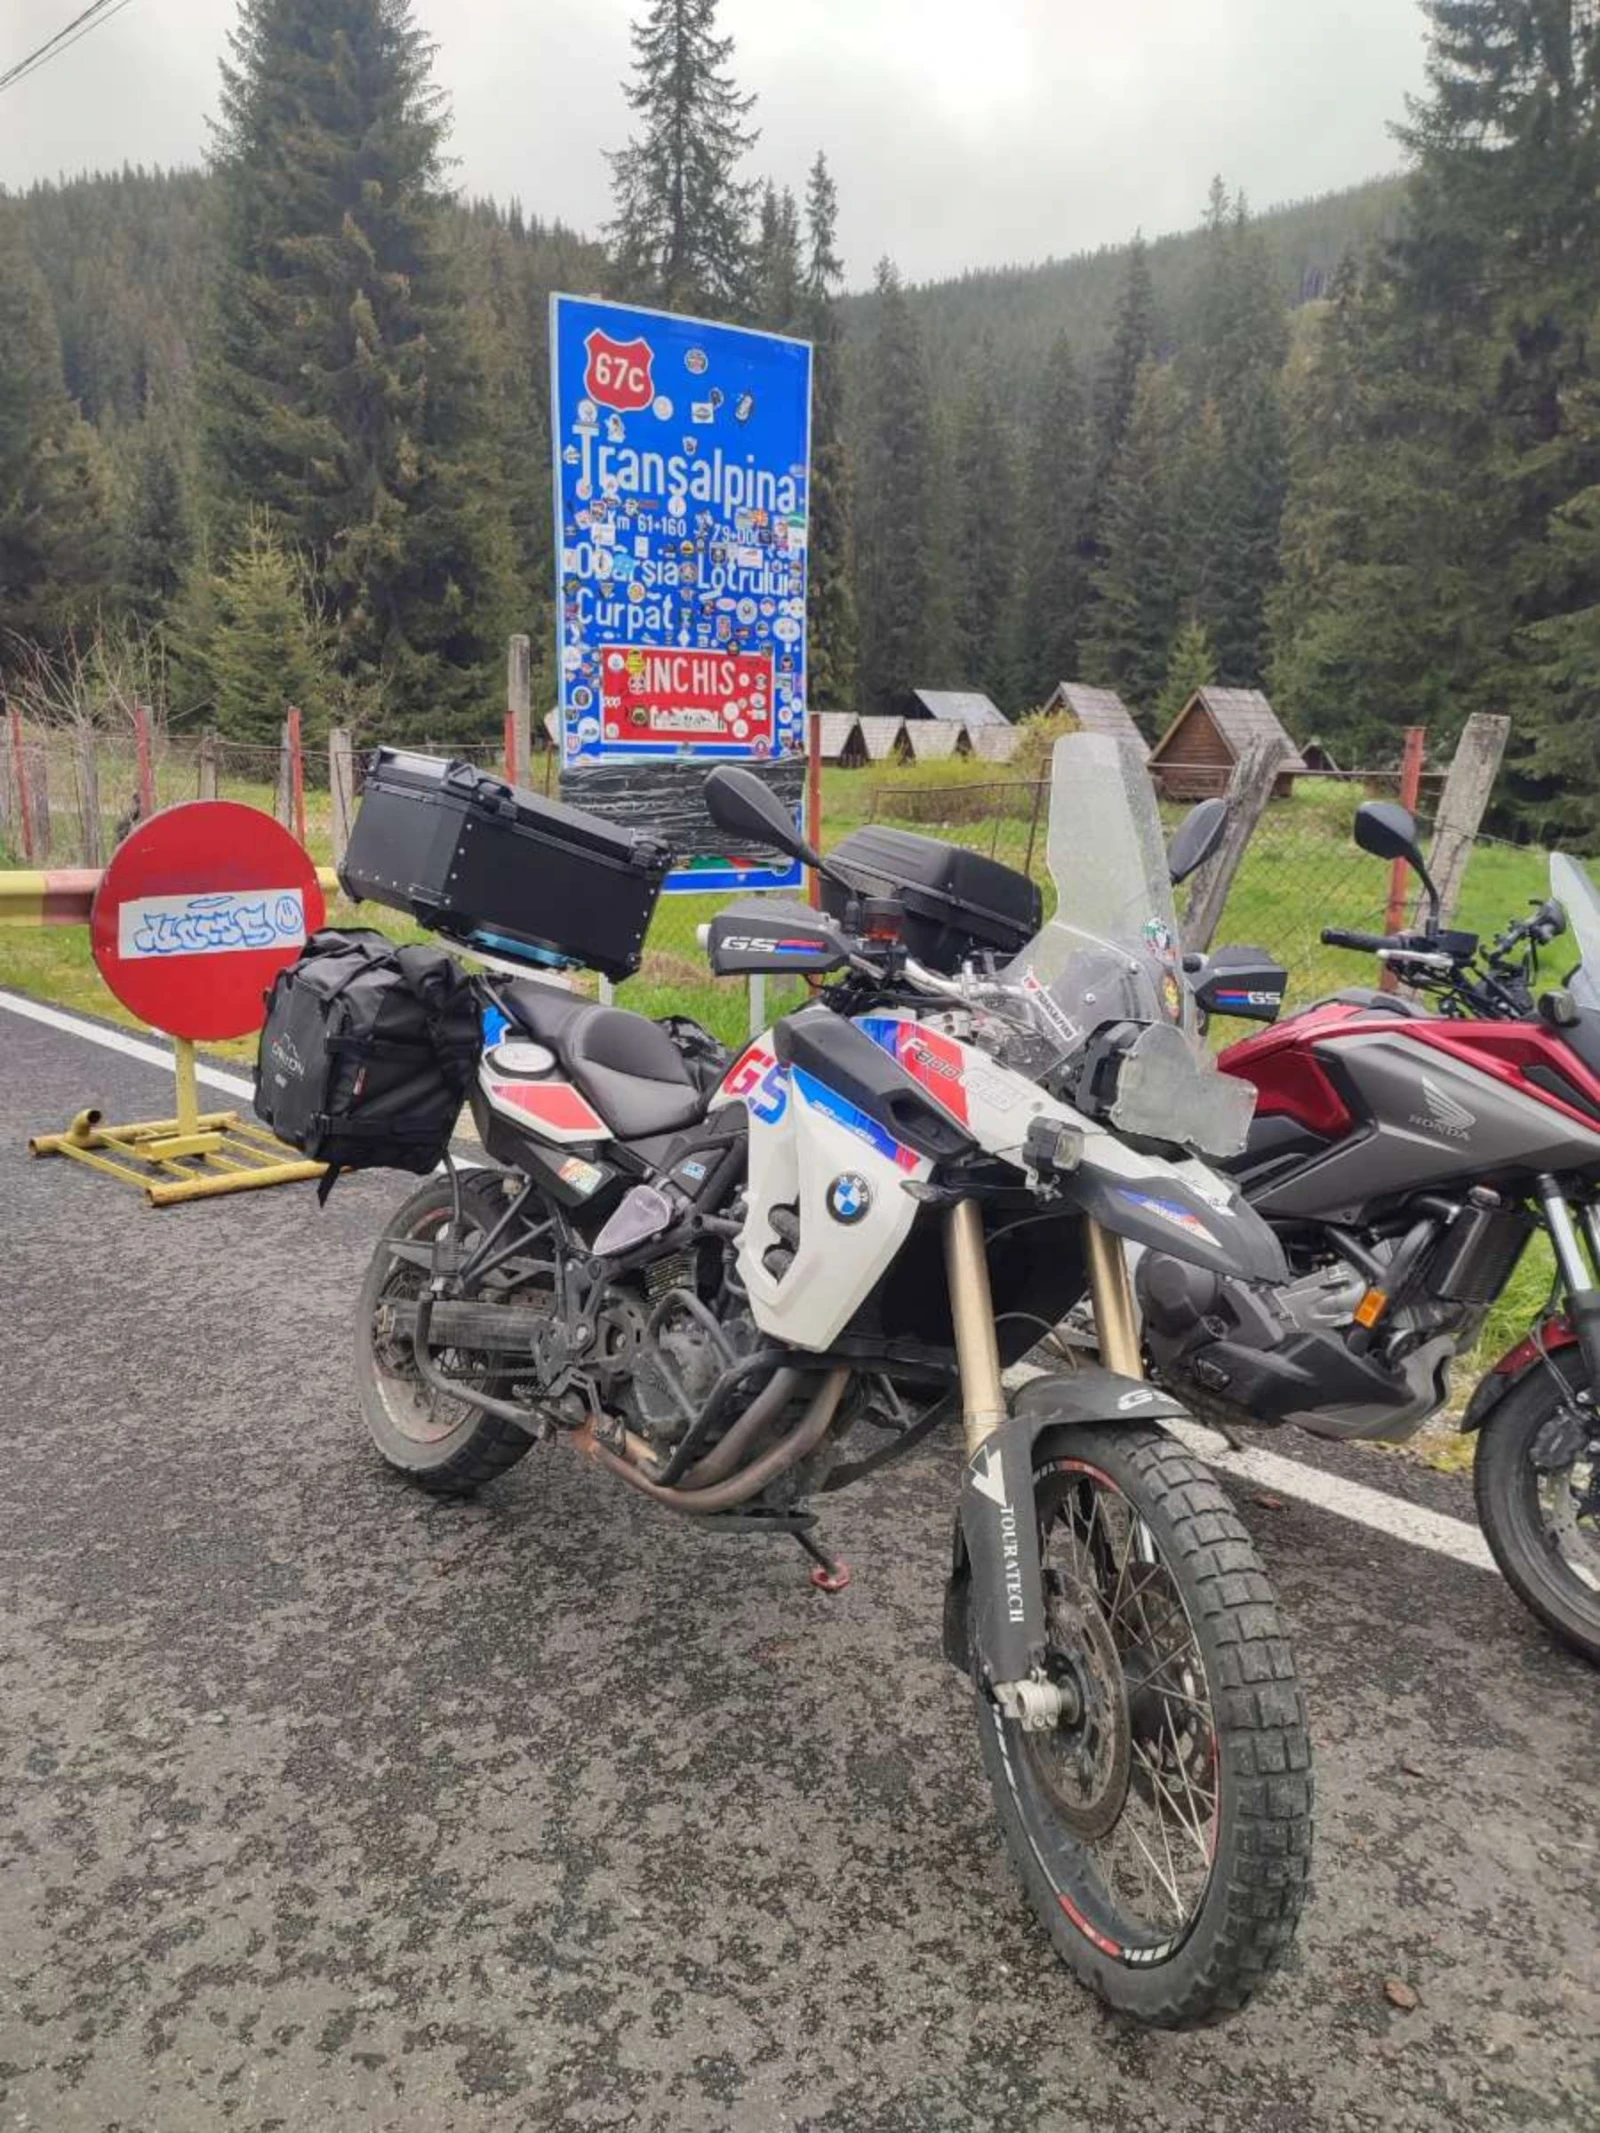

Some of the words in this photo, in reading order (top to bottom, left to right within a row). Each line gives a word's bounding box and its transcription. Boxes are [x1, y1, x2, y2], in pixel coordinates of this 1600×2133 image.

[572, 424, 797, 519] Transalpina
[637, 514, 687, 537] 61+160
[720, 936, 779, 952] GS
[1247, 991, 1281, 1005] GS
[723, 1047, 790, 1125] GS
[1408, 1113, 1471, 1140] HONDA
[1000, 1503, 1025, 1622] TOURATECH
